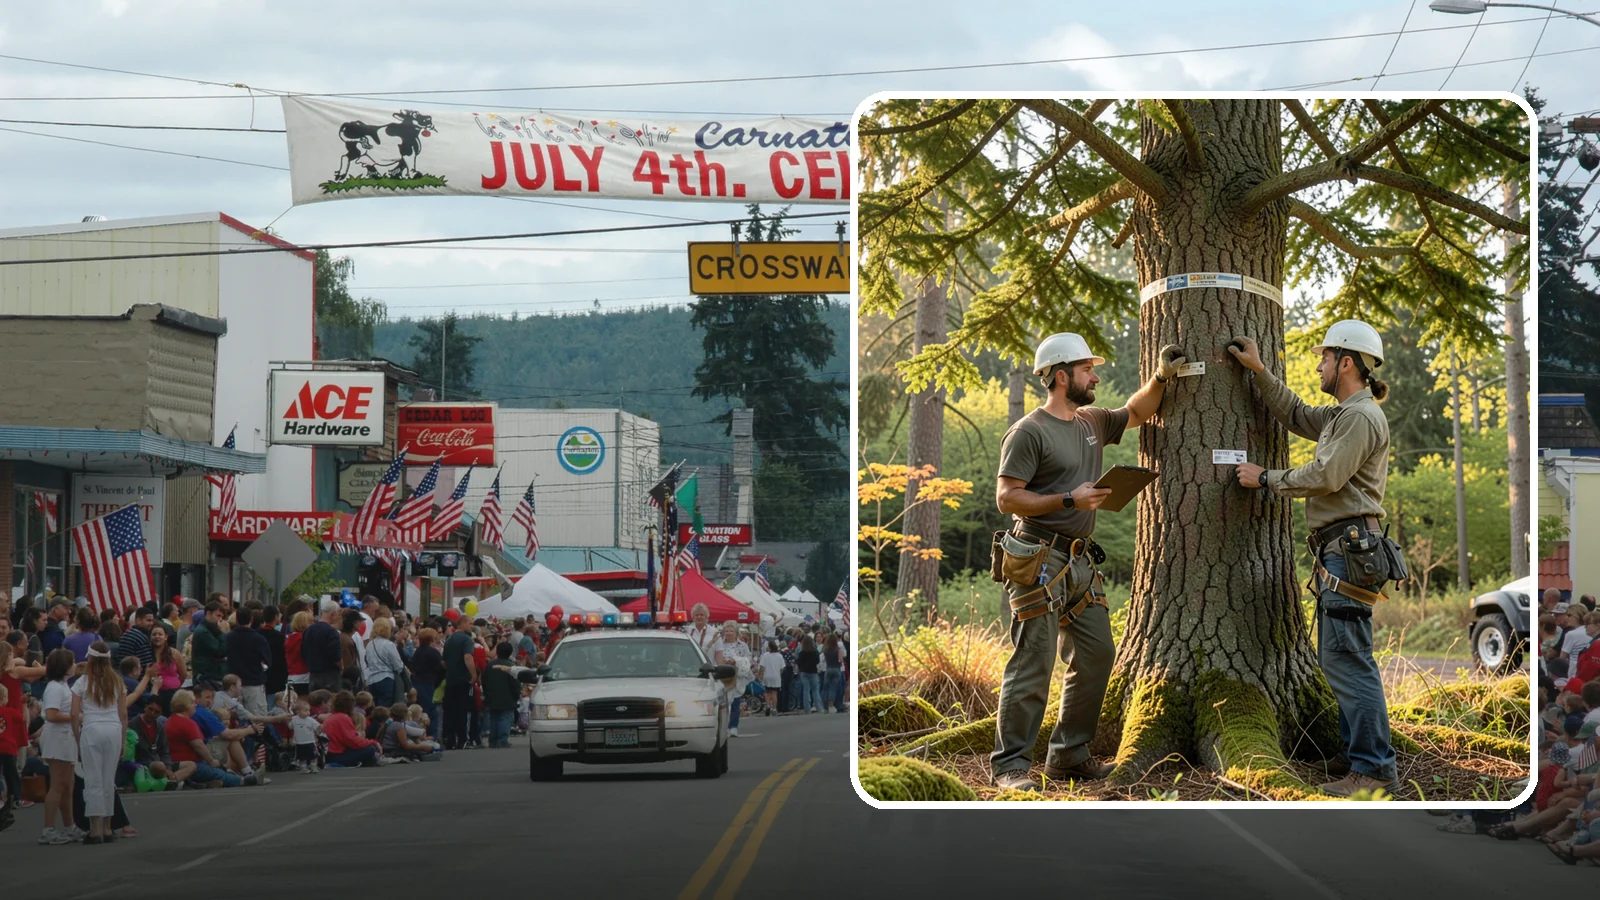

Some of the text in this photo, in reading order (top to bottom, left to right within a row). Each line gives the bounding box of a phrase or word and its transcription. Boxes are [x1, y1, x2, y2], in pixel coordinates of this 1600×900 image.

[481, 141, 605, 193] JULY
[632, 150, 746, 198] 4th.
[697, 254, 850, 280] CROSSWA
[283, 380, 373, 420] ACE
[405, 409, 485, 422] CEDAR LOG
[283, 421, 371, 437] Hardware
[416, 428, 477, 447] Coca-Cola
[353, 467, 386, 480] Simpl
[83, 484, 155, 495] St. Vincent de Paul
[688, 526, 742, 535] CRNATION
[699, 535, 731, 543] GLASS
